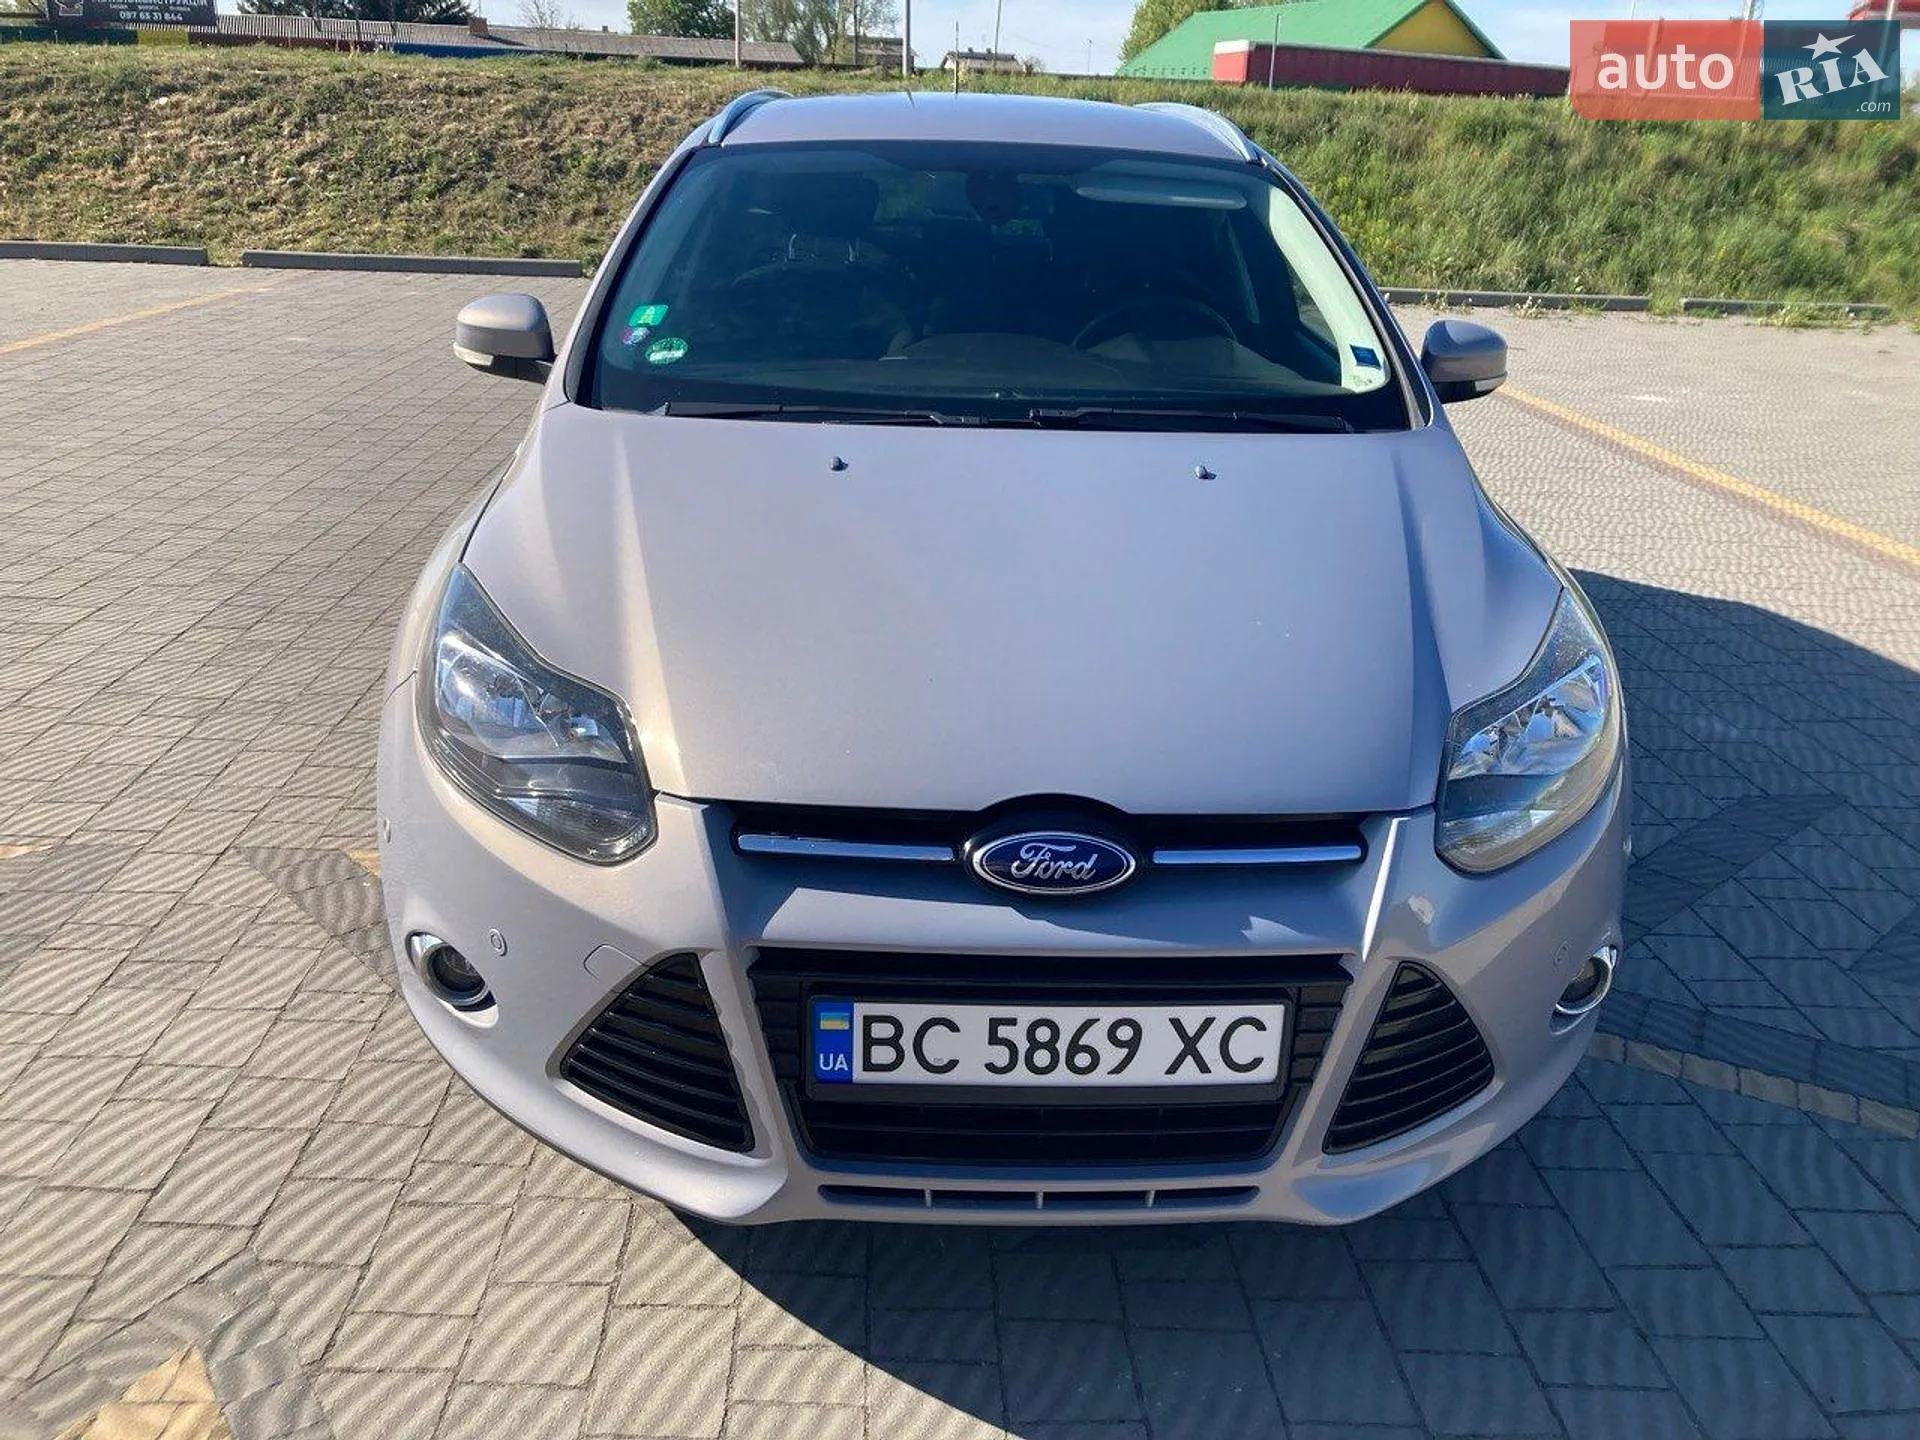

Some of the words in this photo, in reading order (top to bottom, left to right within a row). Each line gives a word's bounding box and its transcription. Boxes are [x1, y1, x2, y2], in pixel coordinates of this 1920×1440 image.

[1011, 842, 1099, 880] Ford
[818, 1053, 849, 1072] UA
[861, 1014, 961, 1074] BC
[983, 1016, 1143, 1076] 5869
[1164, 1015, 1268, 1075] XC
